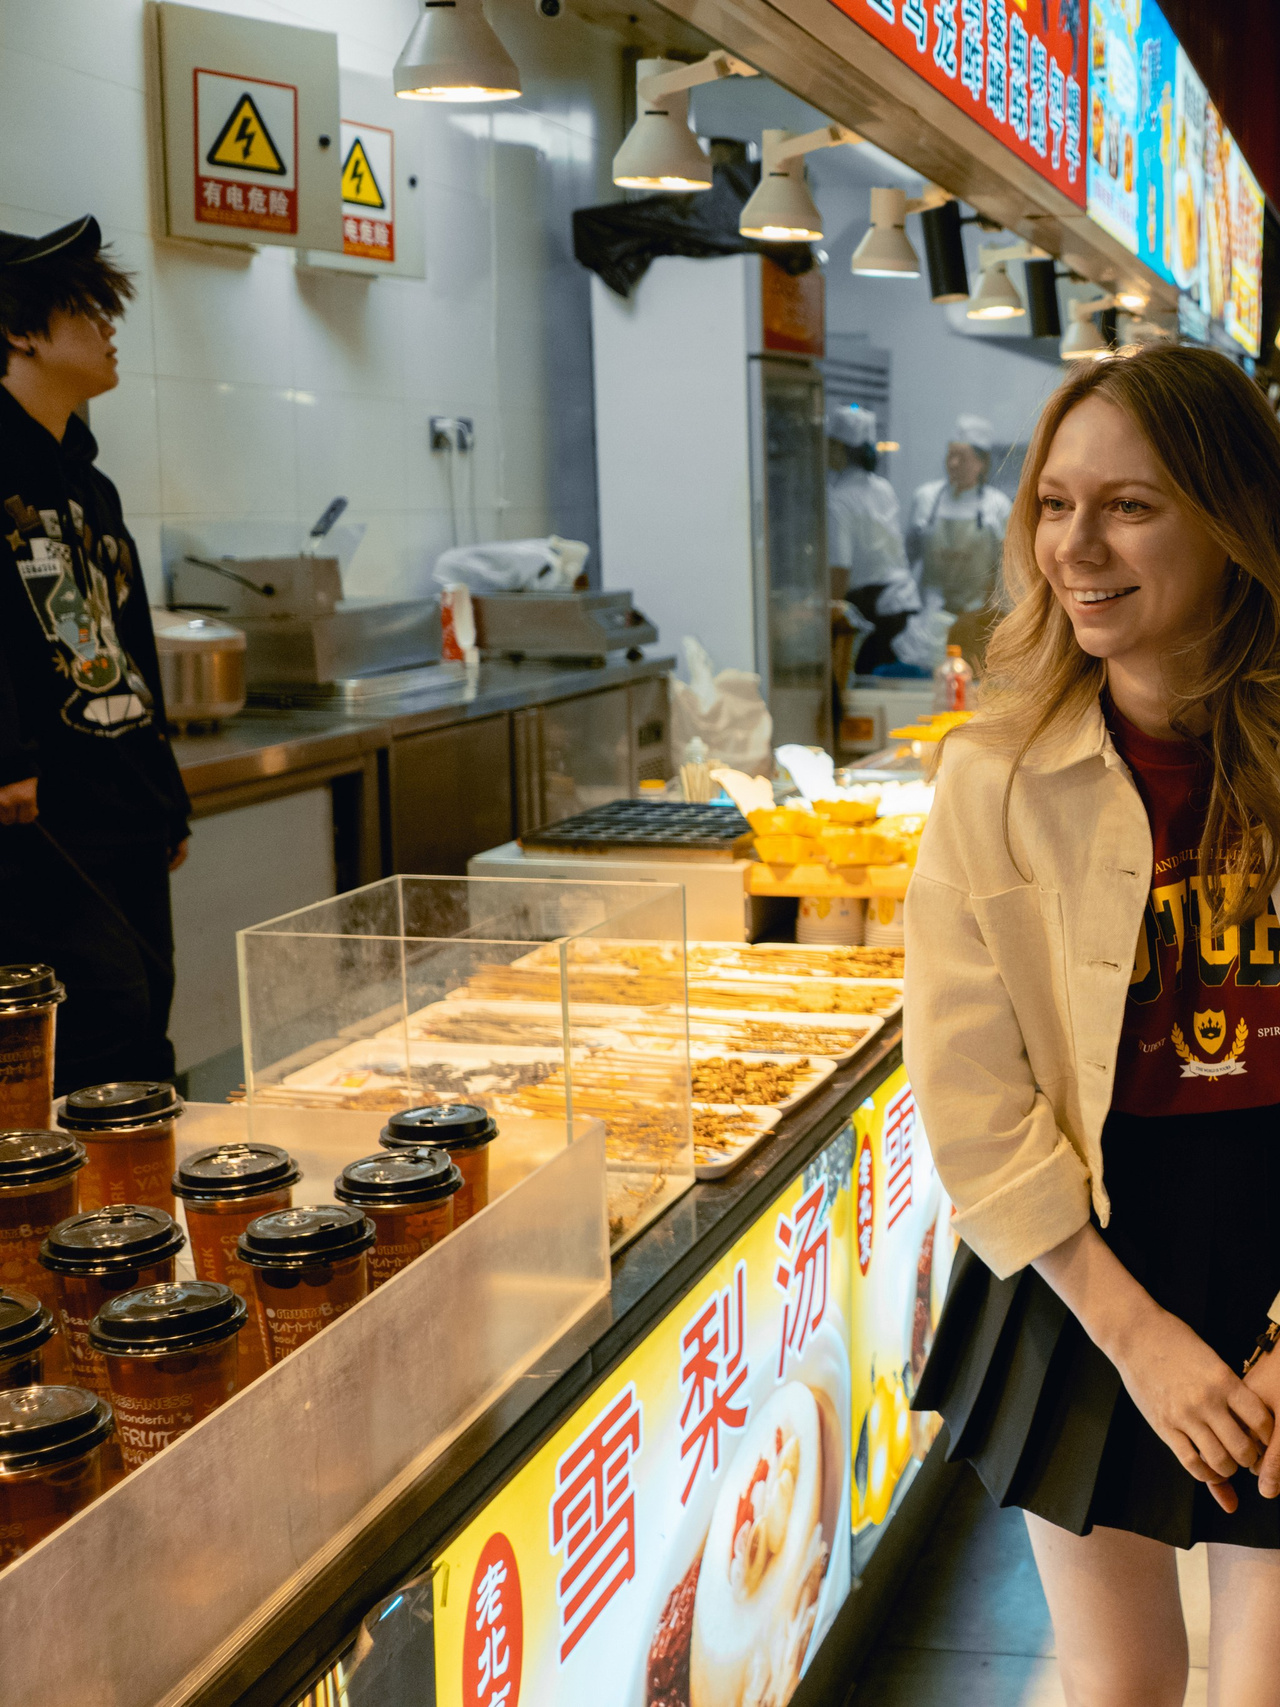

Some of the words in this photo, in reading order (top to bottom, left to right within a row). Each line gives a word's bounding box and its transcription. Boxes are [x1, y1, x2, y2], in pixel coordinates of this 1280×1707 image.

[203, 180, 290, 217] 有电危险
[550, 1179, 830, 1669] 雪梨汤
